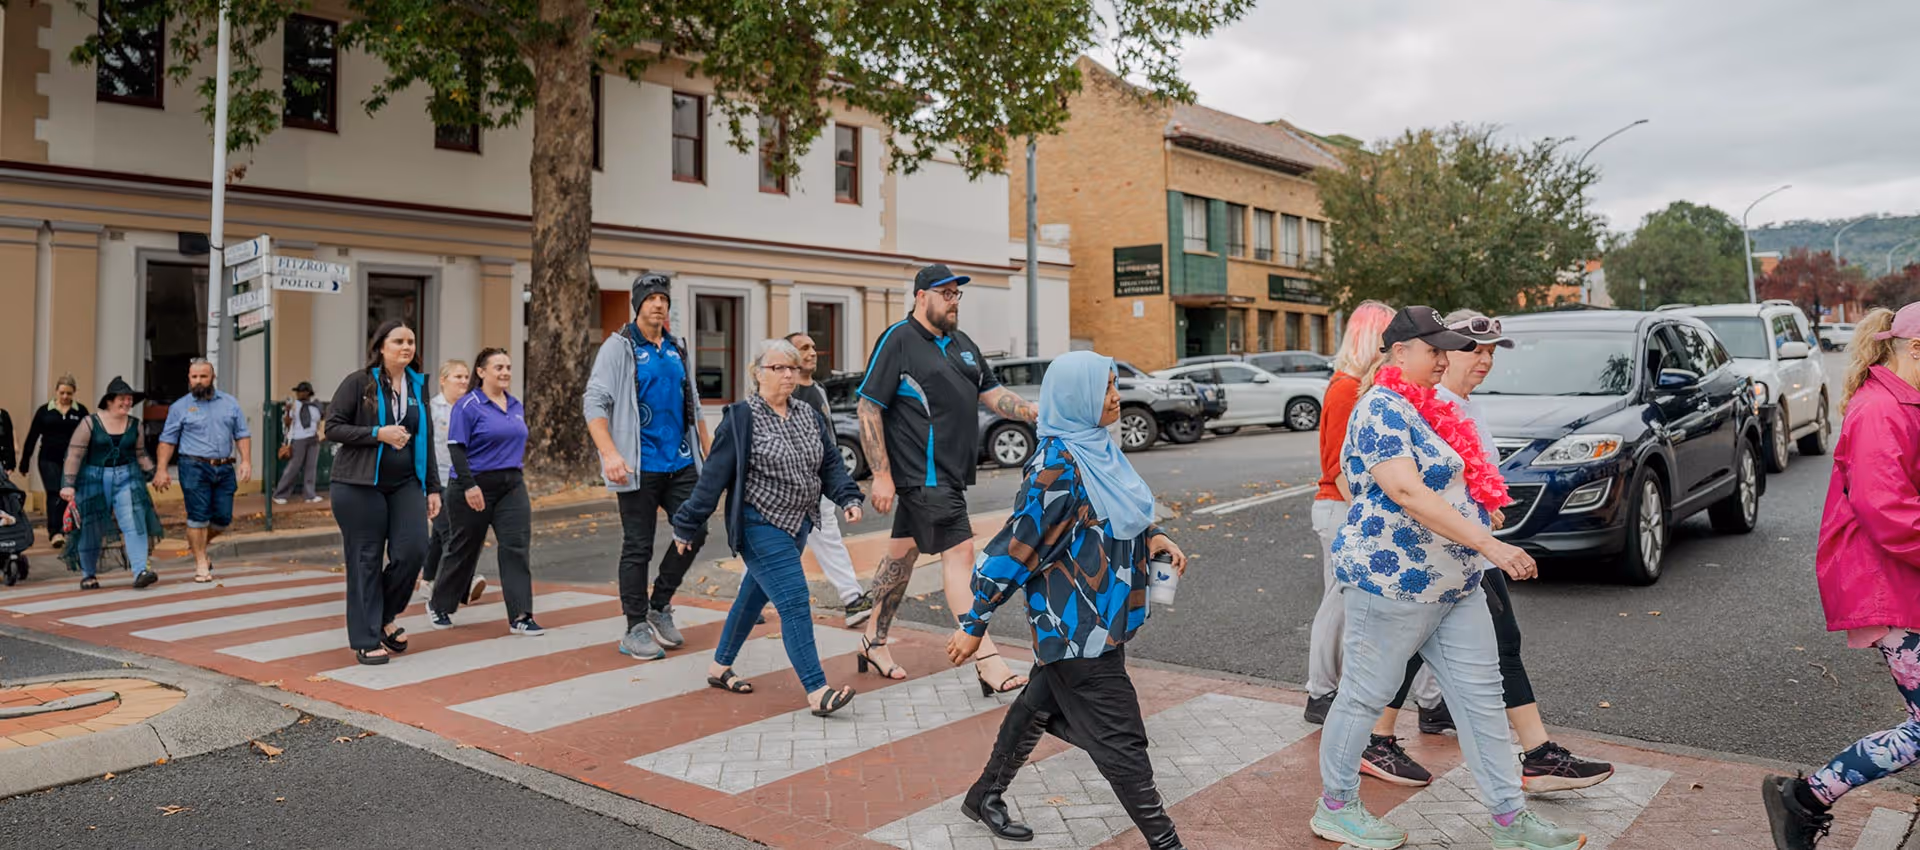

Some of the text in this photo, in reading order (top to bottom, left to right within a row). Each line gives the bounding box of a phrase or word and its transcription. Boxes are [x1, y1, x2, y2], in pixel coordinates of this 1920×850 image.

[278, 257, 347, 275] FITZROY ST
[281, 277, 325, 289] POLICE
